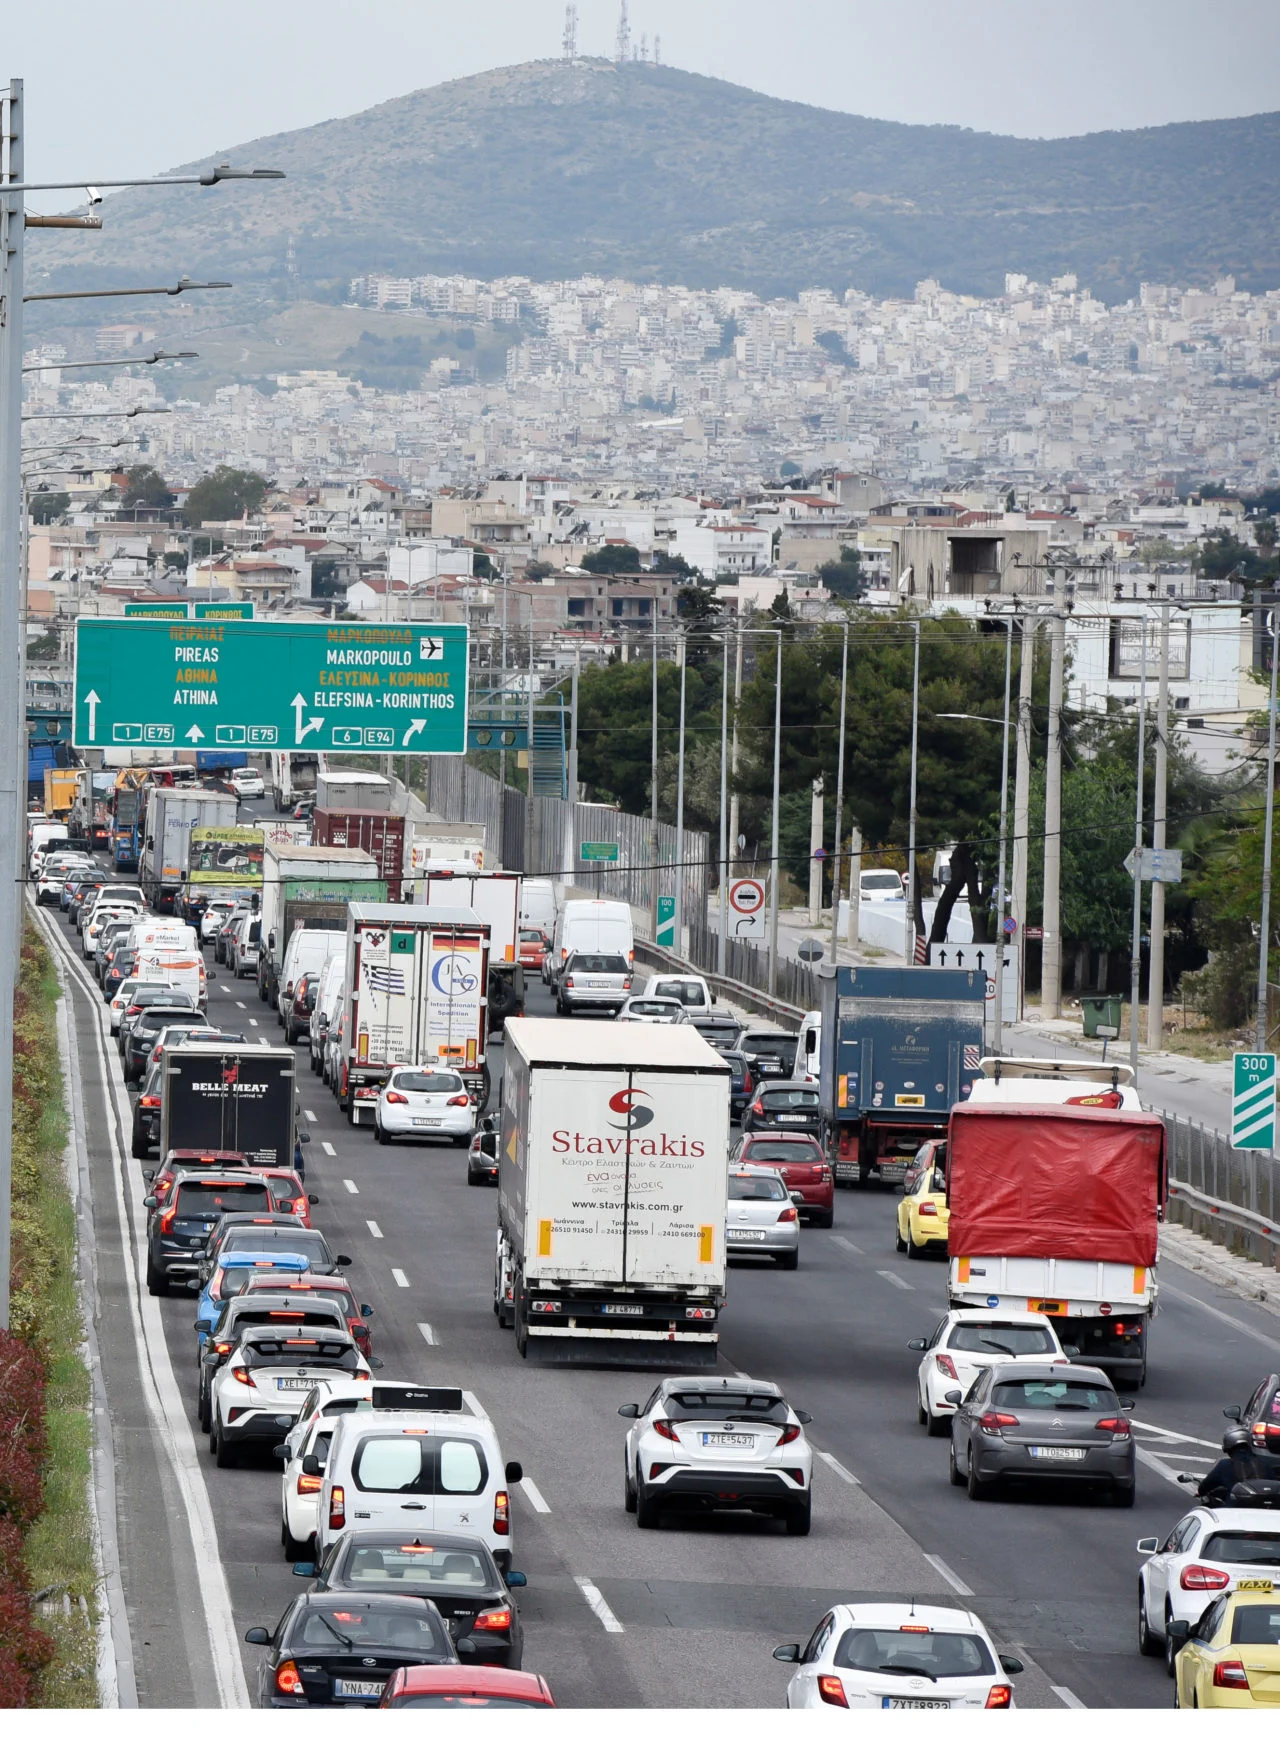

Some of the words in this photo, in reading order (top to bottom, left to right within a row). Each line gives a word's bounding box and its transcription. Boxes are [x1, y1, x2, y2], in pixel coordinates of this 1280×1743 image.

[170, 625, 225, 642] ΠΕΙΡΑΙΑΣ
[327, 628, 413, 644] ΜΑΡΚΟΠΟΥΛΟ
[175, 647, 219, 662] PIREAS
[327, 650, 412, 666] MARKOPOULO
[175, 668, 218, 684] ΑΘΗΝΑ
[173, 689, 218, 705] ATHINA
[343, 731, 351, 742] 6
[661, 898, 672, 906] 100
[1242, 1057, 1268, 1071] 300
[1249, 1074, 1260, 1082] m
[192, 1083, 229, 1091] BELLE
[233, 1083, 269, 1092] MEAT
[552, 1130, 705, 1158] Stavrakis
[611, 1219, 639, 1227] Τρίαλα
[1240, 1580, 1272, 1589] TAXI
